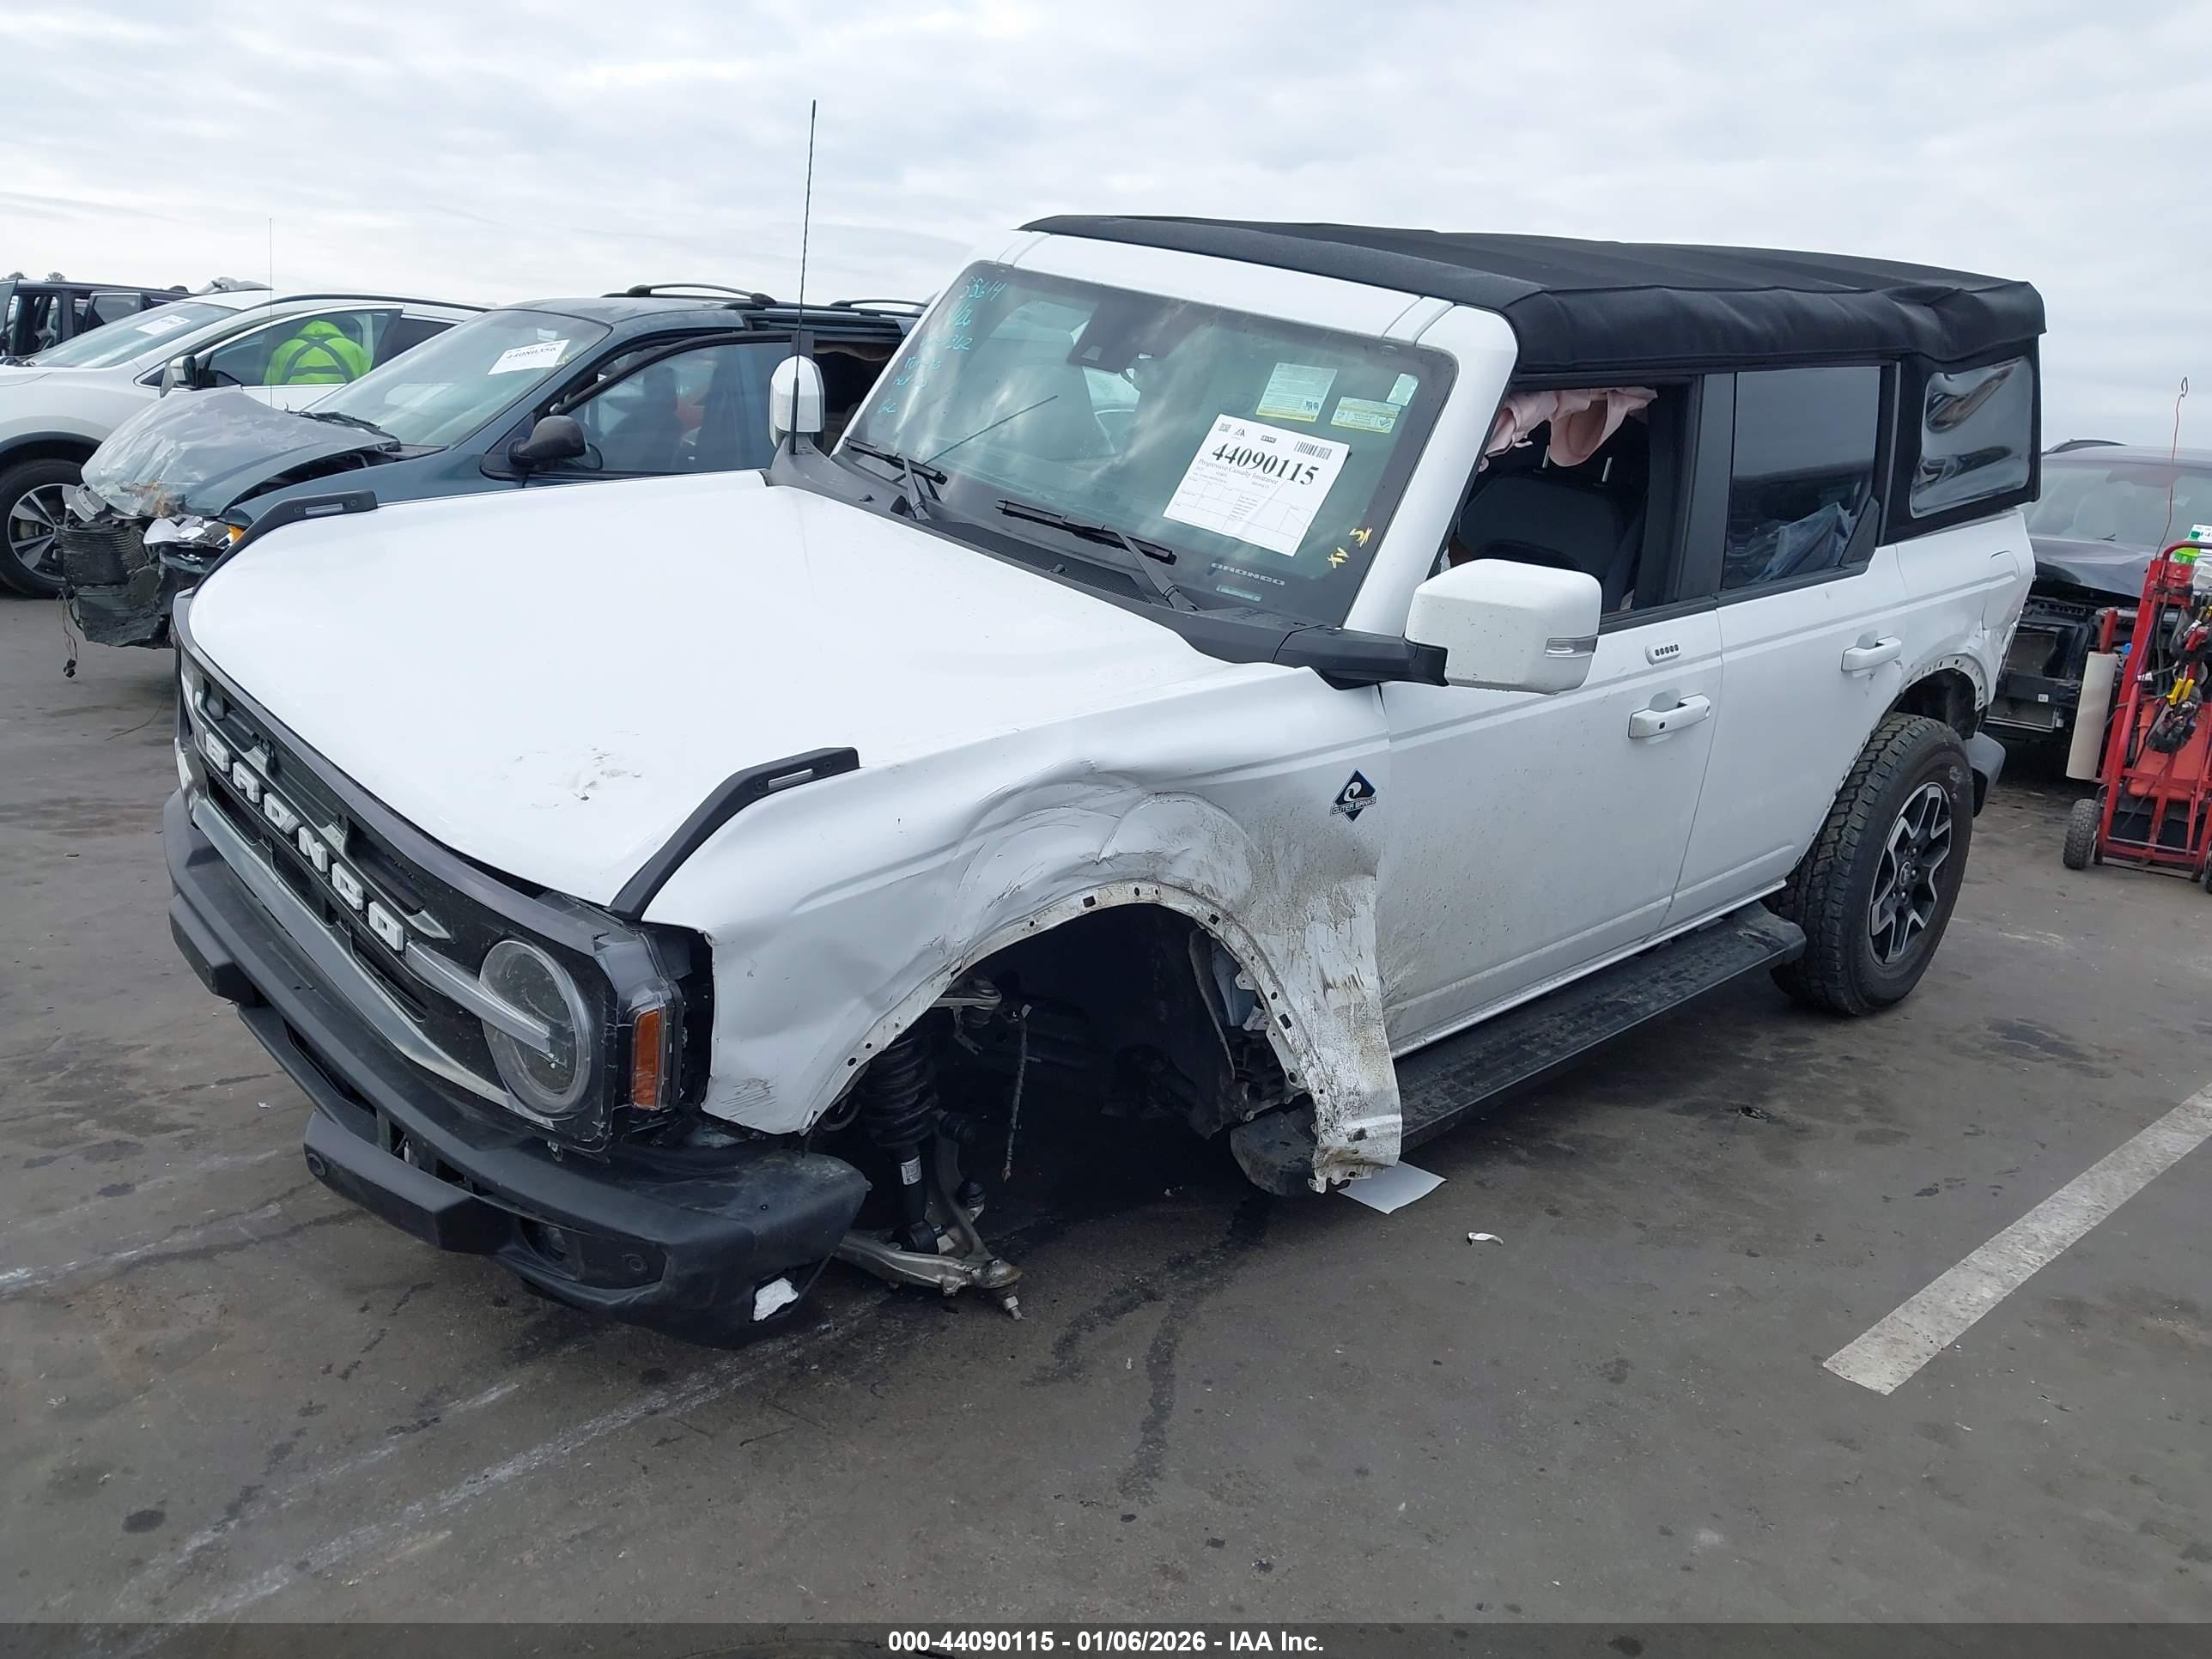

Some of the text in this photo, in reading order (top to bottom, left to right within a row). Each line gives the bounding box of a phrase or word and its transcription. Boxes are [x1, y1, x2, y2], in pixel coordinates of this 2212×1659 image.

[1198, 459, 1228, 474] Progressive
[1228, 465, 1251, 478] Casualty
[1252, 472, 1279, 485] Insurance
[1212, 442, 1320, 486] 44090115
[206, 732, 404, 951] BRONCO
